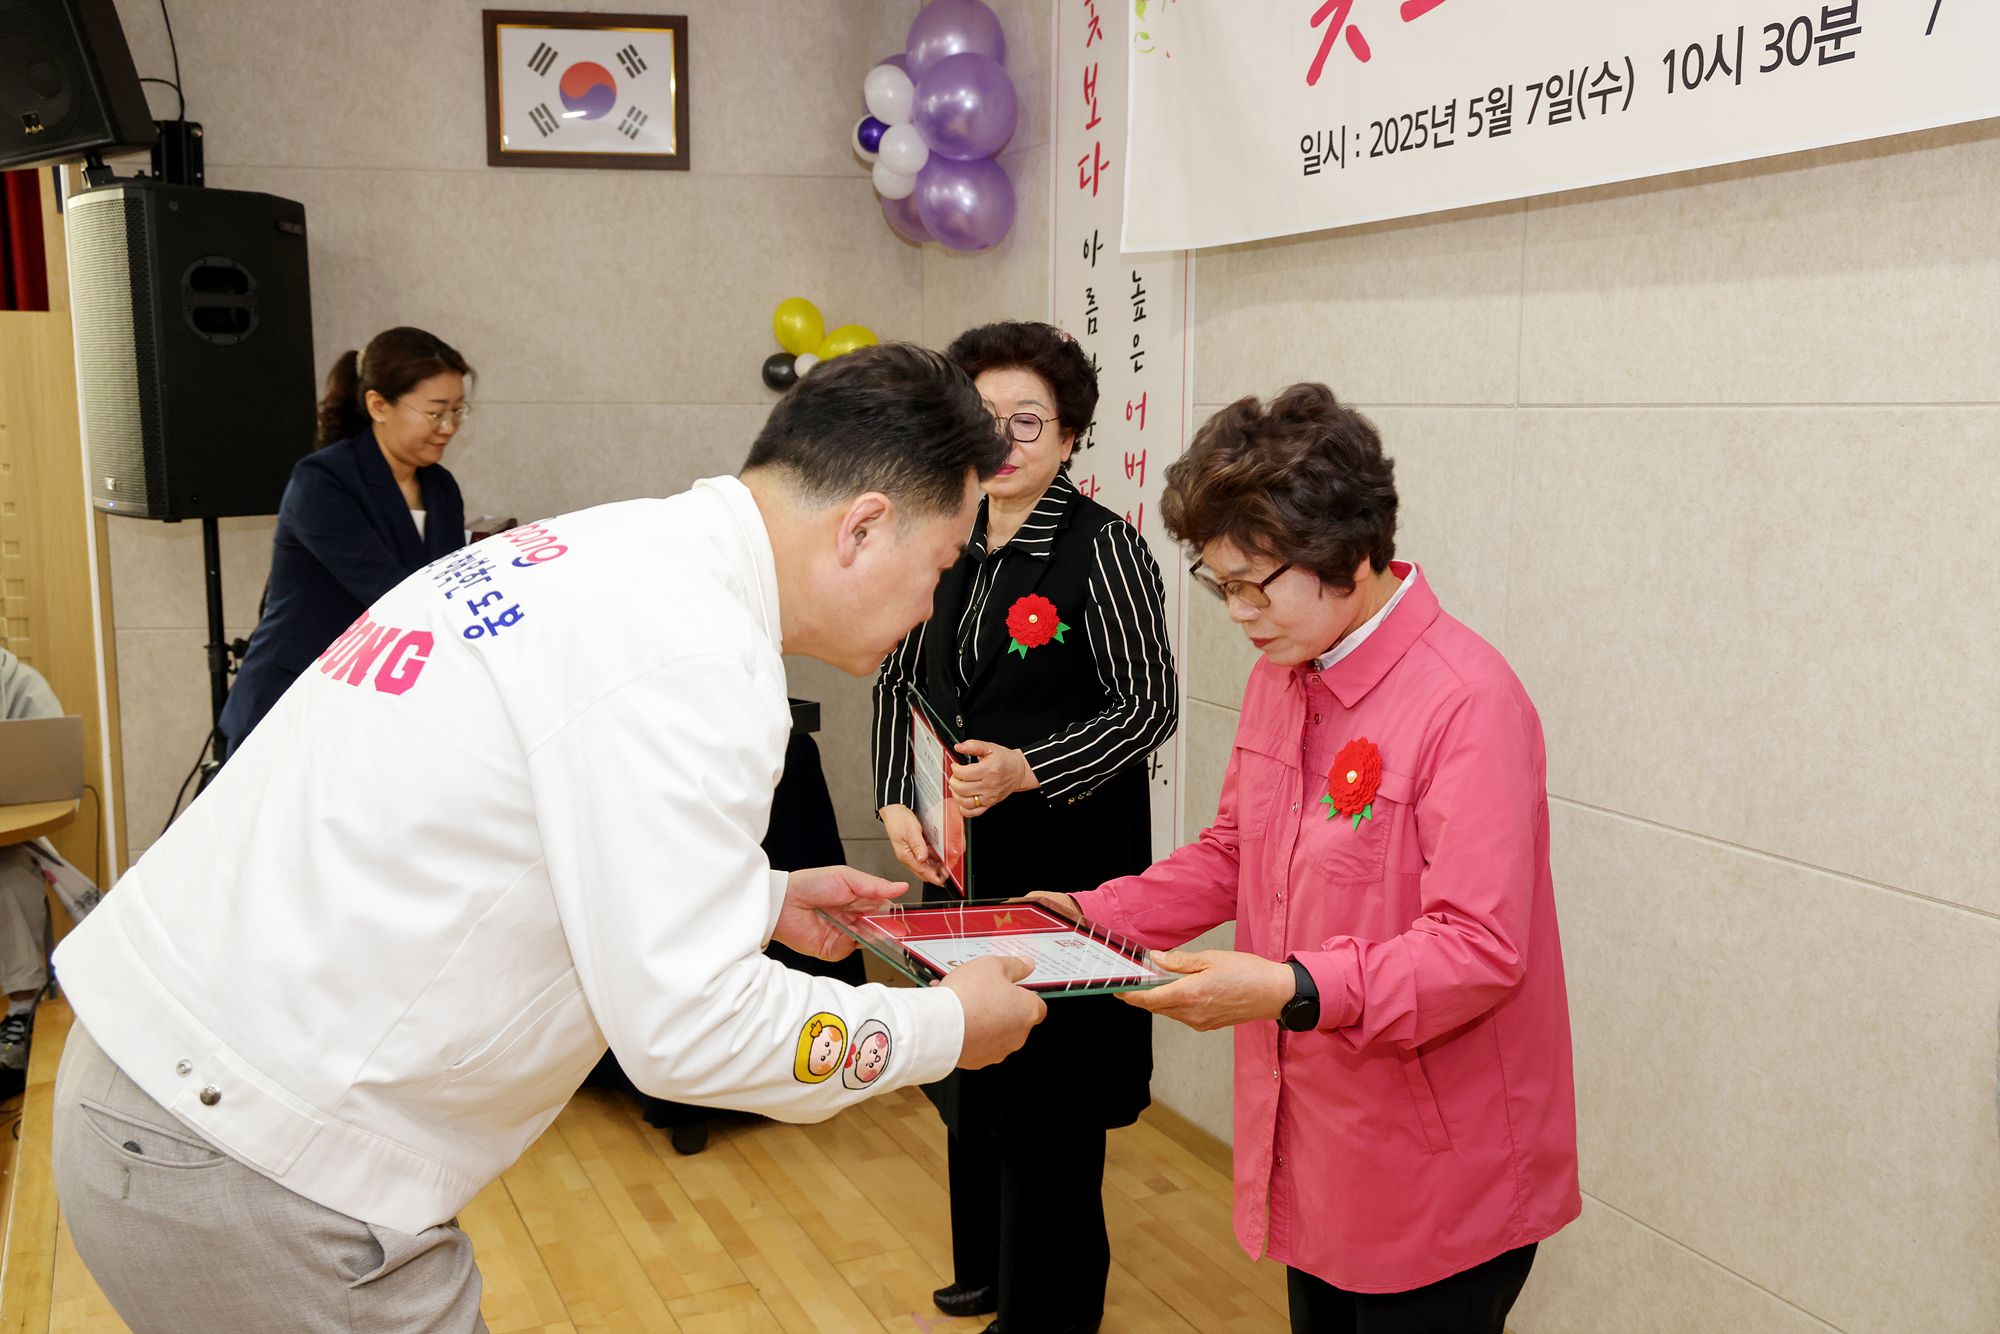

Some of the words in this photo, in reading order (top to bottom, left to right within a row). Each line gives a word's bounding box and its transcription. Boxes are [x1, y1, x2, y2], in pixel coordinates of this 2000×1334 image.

[1299, 125, 1346, 176] 일시
[1370, 98, 1457, 159] 2025년
[1467, 85, 1513, 139] 5월
[1526, 55, 1635, 126] 7일(수)
[1662, 25, 1745, 95] 10시
[1759, 0, 1862, 73] 30분
[1130, 270, 1147, 374] 높은
[462, 589, 525, 640] 도봉
